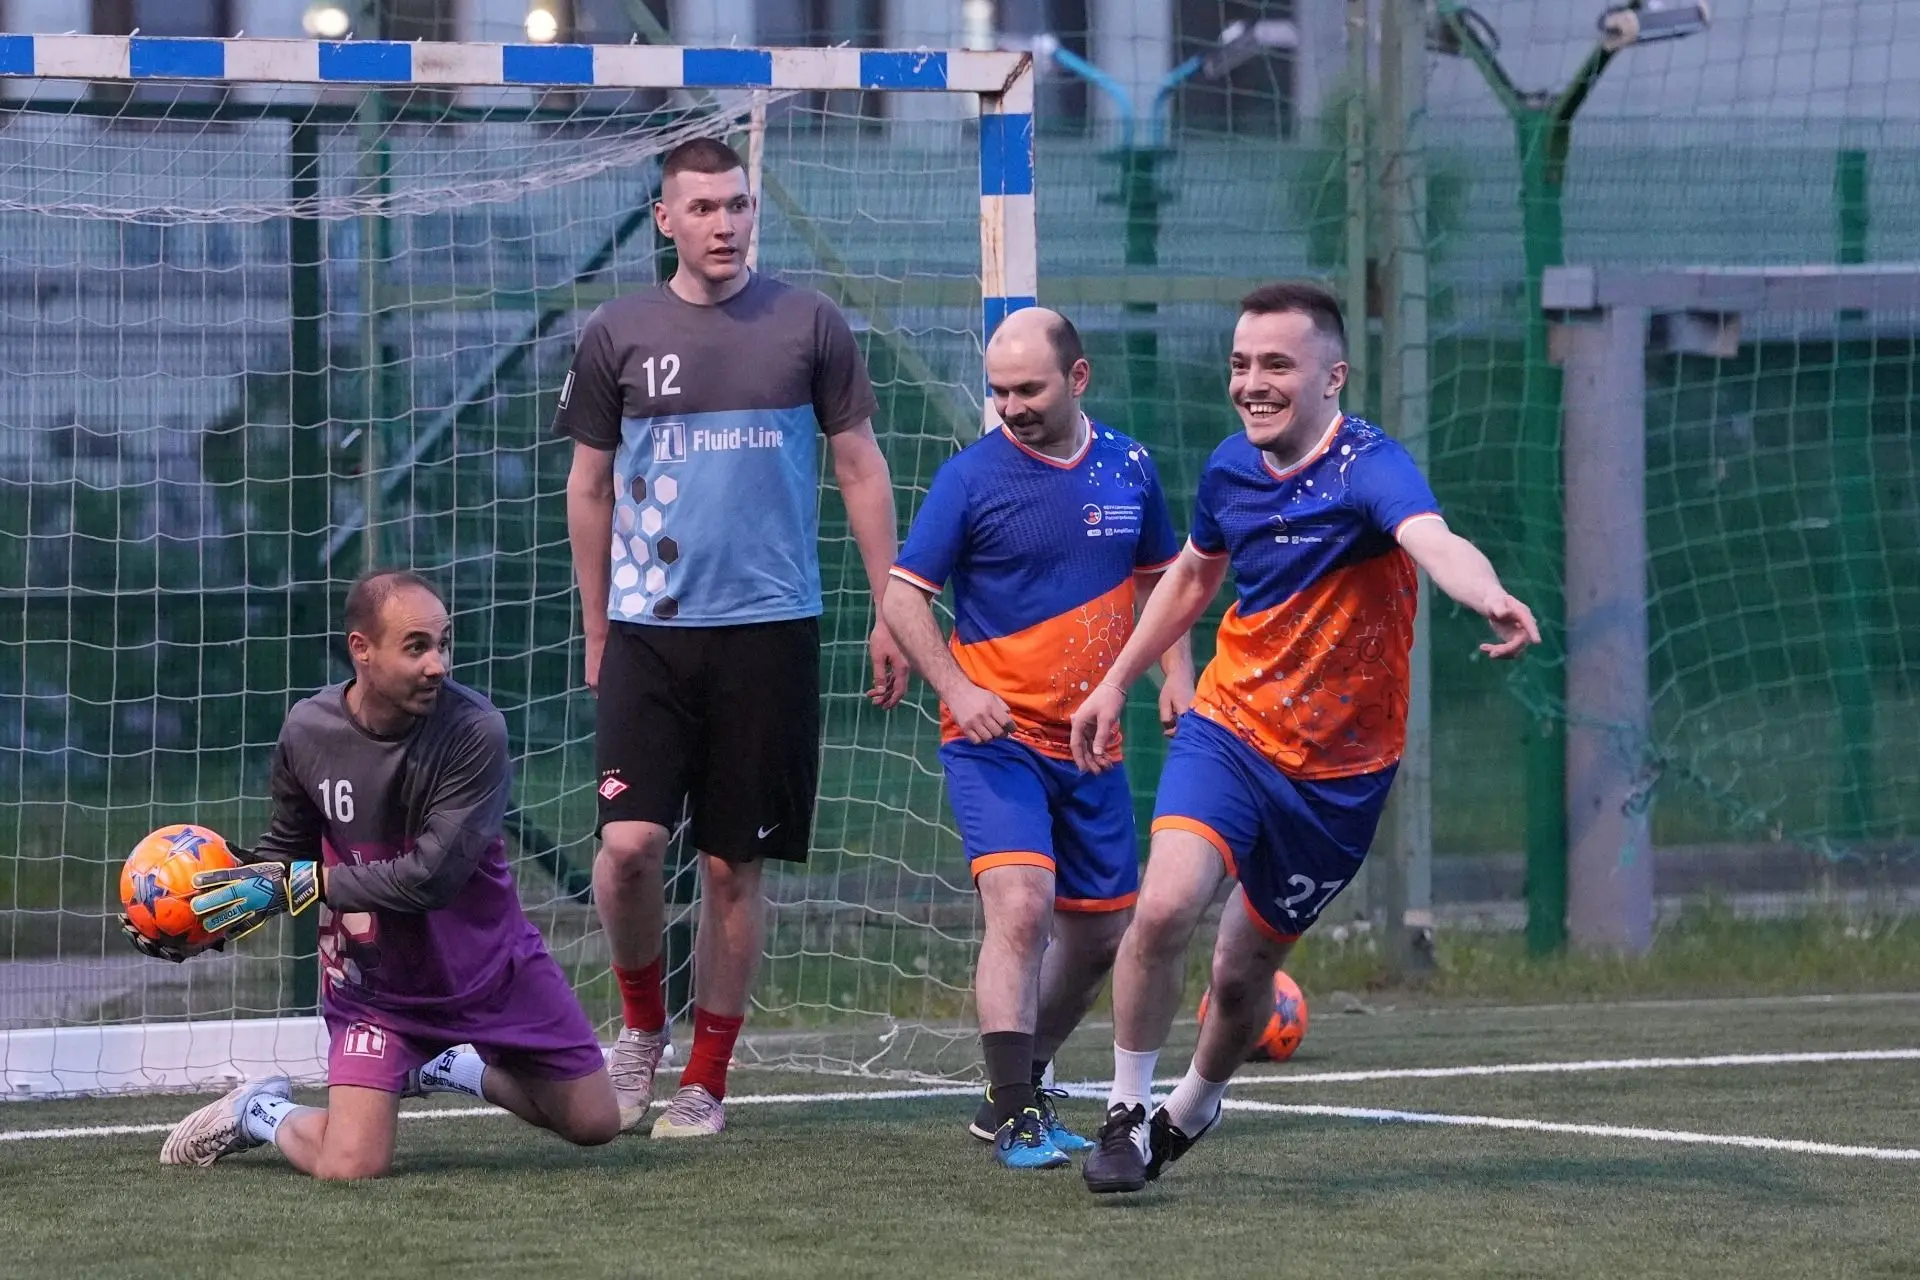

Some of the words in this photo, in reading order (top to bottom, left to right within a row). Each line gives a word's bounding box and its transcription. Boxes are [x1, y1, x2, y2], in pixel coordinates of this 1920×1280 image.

[642, 353, 681, 397] 12
[693, 427, 784, 452] Fluid-Line
[318, 778, 354, 823] 16
[1273, 873, 1345, 918] 27
